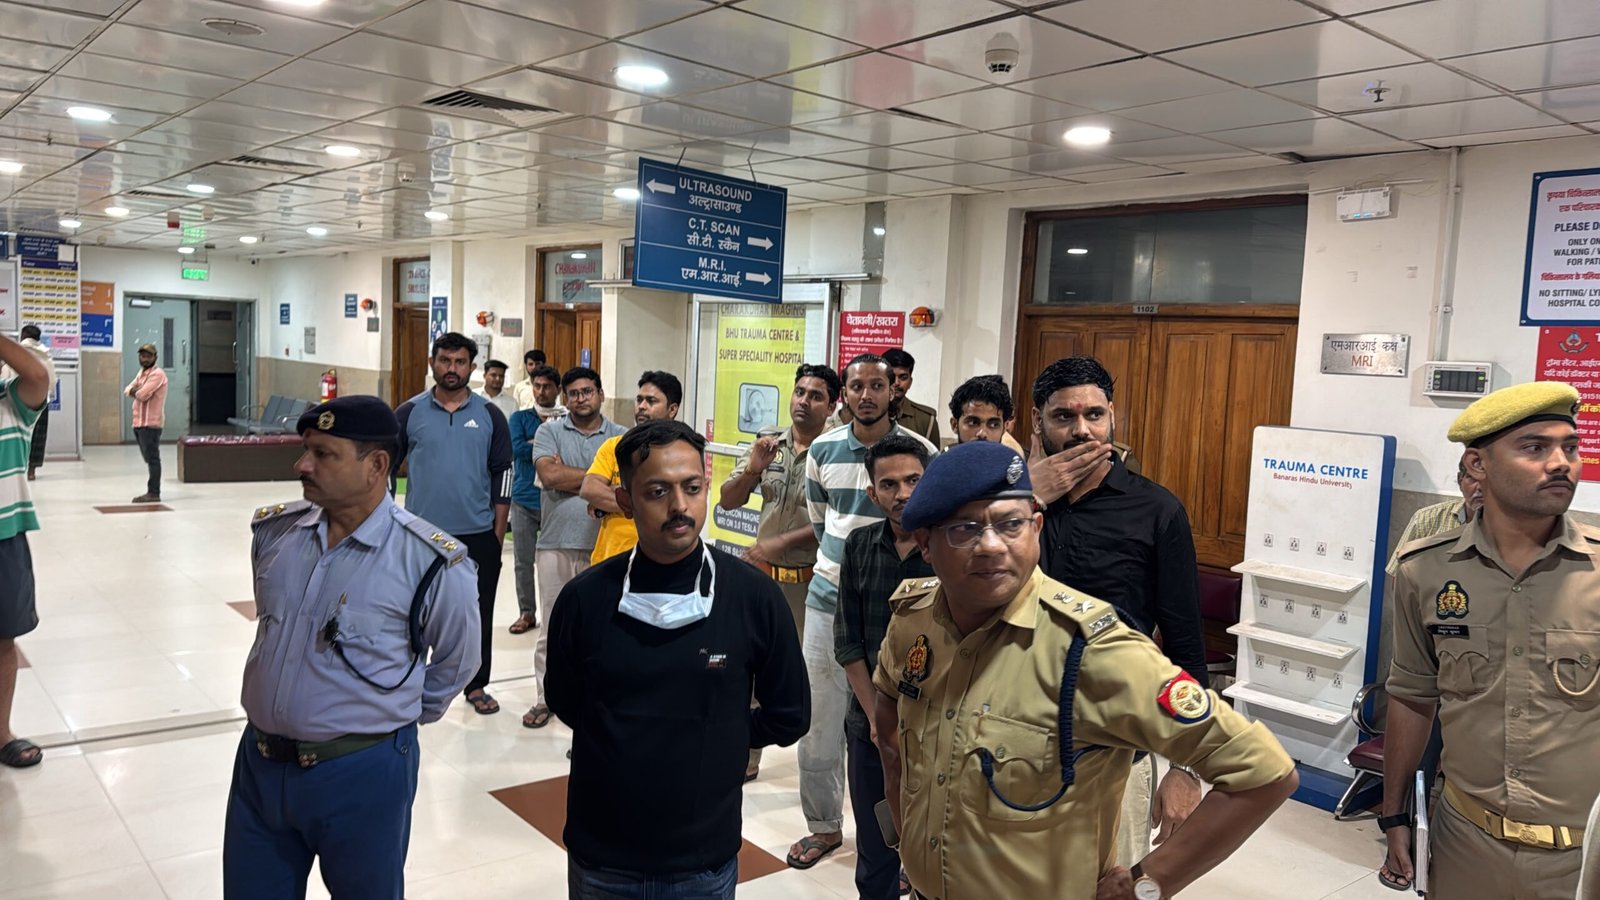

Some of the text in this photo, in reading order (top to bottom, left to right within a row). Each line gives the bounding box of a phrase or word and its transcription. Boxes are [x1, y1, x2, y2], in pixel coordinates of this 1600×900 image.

[679, 177, 752, 202] ULTRASOUND
[688, 194, 742, 214] अल्ट्रासाउण्ड
[688, 218, 740, 236] C.T. SCAN
[1554, 222, 1590, 232] PLEASE
[686, 232, 740, 253] सी.टी. स्कैन
[1568, 238, 1588, 246] ONLY
[1554, 248, 1589, 256] WALKING
[698, 257, 726, 272] M.R.I.
[772, 304, 805, 316] IMAGING
[726, 328, 800, 341] BHU TRAUMA CENTRE &
[1331, 338, 1398, 353] एमआरआई कक्ष
[719, 349, 737, 360] SUPER
[739, 350, 773, 363] SPECIALITY
[1351, 355, 1373, 367] MRI
[1264, 458, 1368, 479] TRAUMA CENTRE
[1273, 473, 1352, 489] Banaras Hindu University
[726, 518, 733, 527] ON
[742, 521, 757, 533] TESLA
